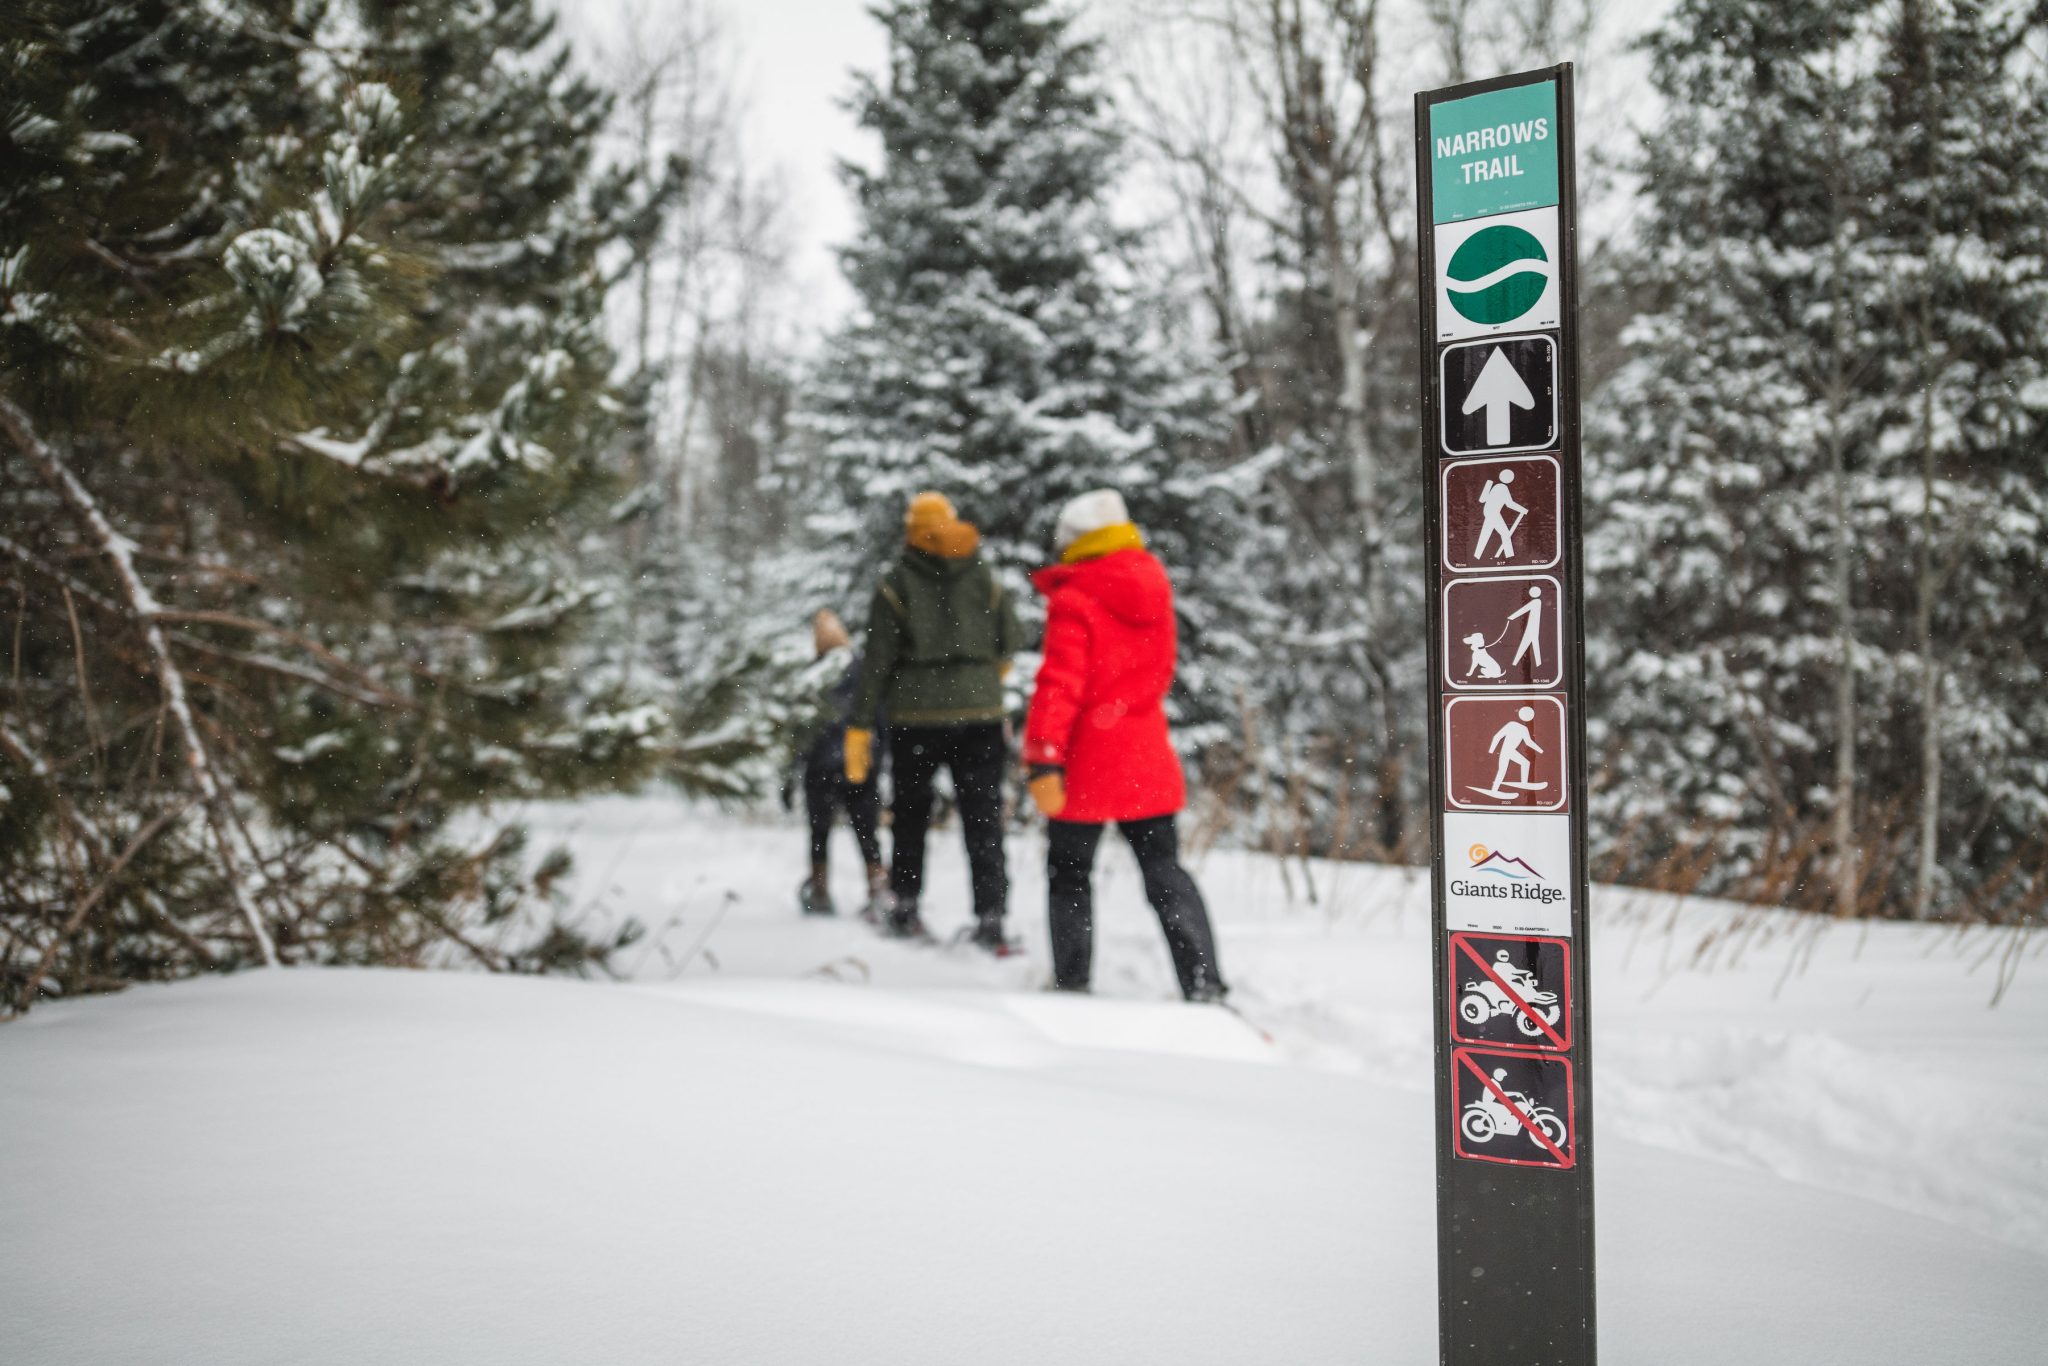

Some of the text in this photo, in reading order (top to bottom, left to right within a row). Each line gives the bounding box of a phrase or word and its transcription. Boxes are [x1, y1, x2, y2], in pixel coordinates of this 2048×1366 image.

[1437, 118, 1548, 159] NARROWS
[1461, 155, 1524, 185] TRAIL
[1450, 880, 1508, 899] Giants
